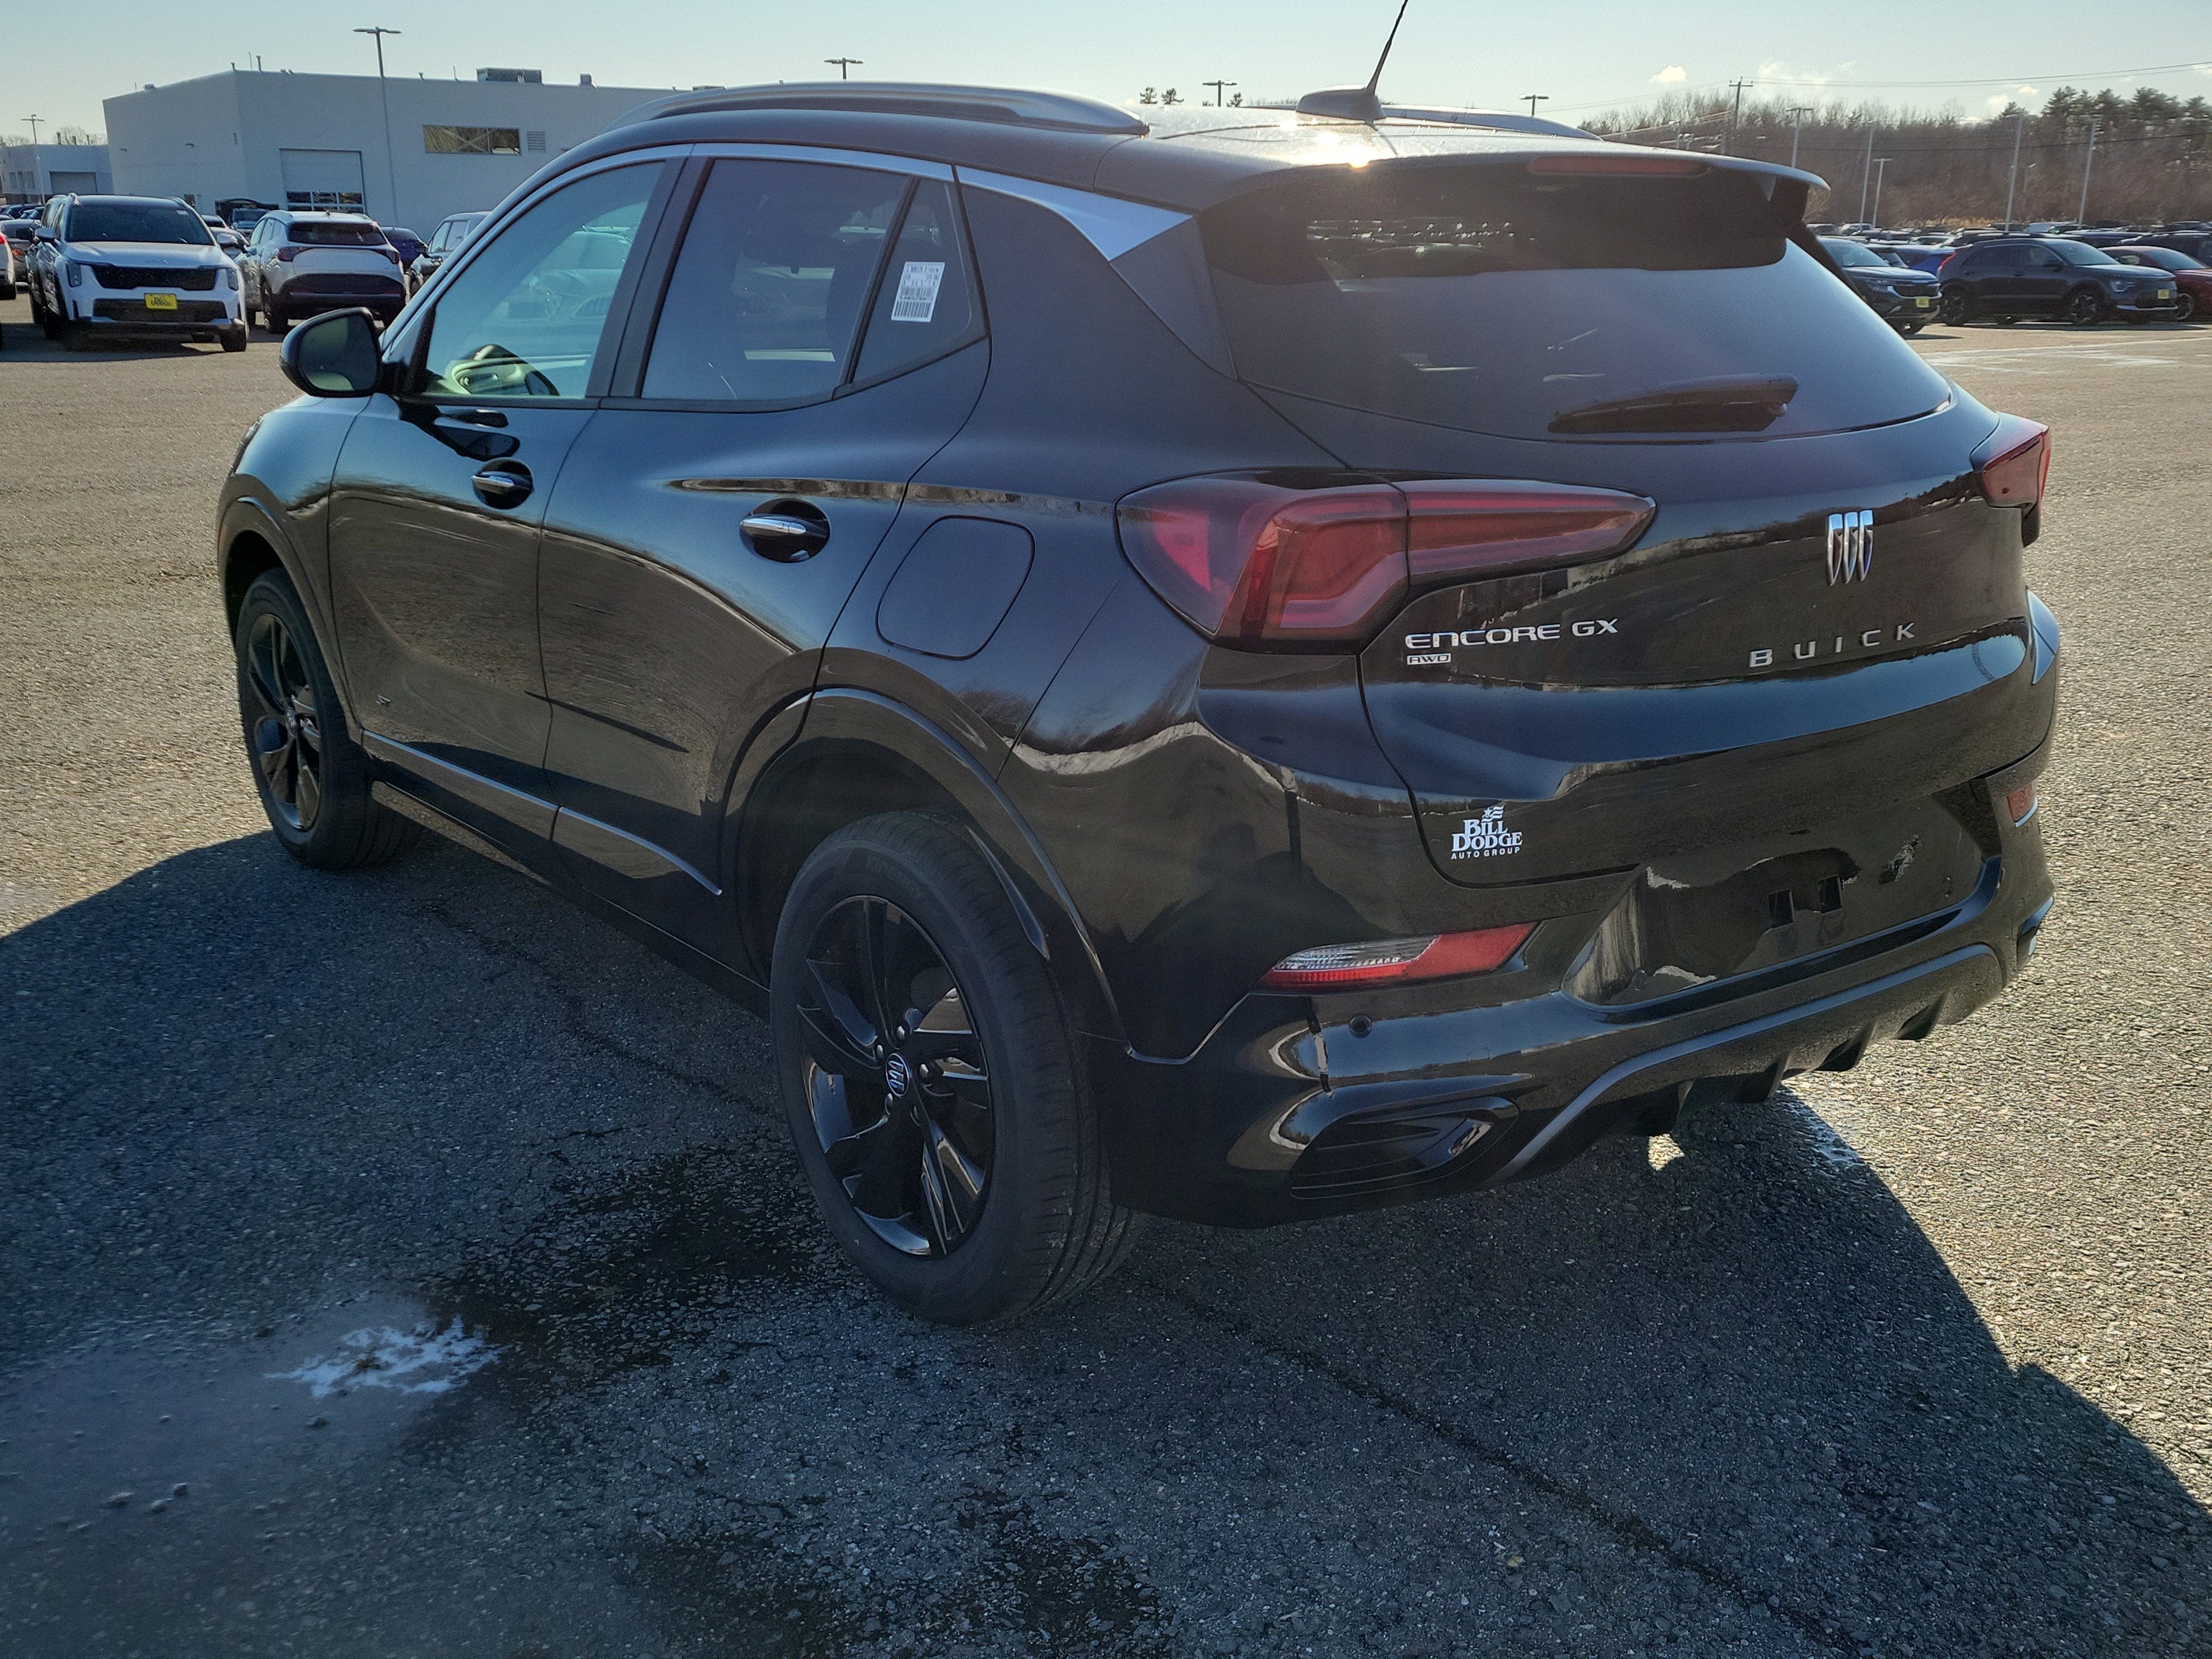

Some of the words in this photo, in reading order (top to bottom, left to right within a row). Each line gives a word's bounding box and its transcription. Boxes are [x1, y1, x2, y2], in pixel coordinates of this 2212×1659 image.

[1405, 624, 1561, 649] ENCORE
[1571, 618, 1618, 636] GX
[1749, 622, 1915, 668] BUICK
[1409, 654, 1449, 664] AWD
[1463, 819, 1508, 837] BILL
[1451, 832, 1523, 852] DODGE
[1451, 851, 1480, 860] AUTO
[1483, 847, 1521, 857] GROUP
